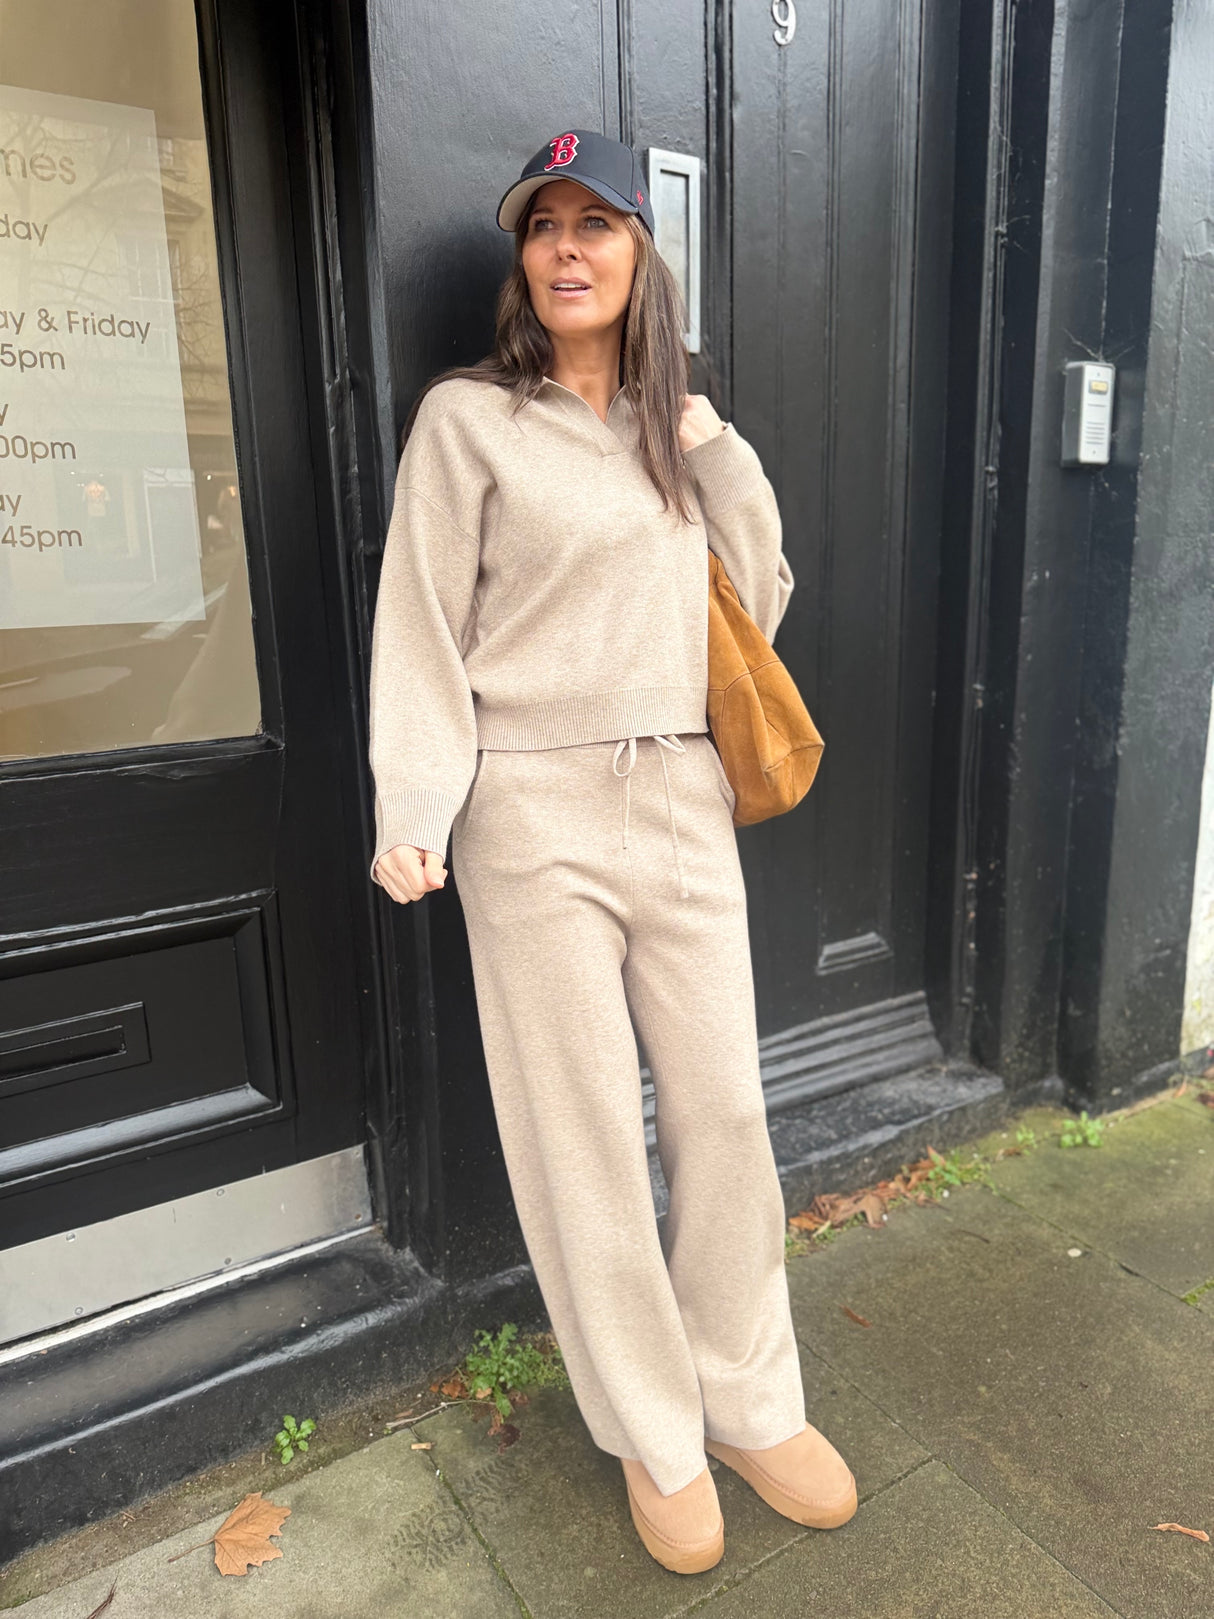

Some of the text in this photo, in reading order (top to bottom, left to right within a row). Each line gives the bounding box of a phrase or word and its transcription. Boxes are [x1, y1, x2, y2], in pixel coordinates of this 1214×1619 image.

[772, 0, 797, 46] 9
[544, 133, 580, 171] B
[37, 308, 59, 333] &
[67, 310, 151, 344] Friday
[0, 343, 66, 373] 5pm
[1, 525, 83, 552] 45pm
